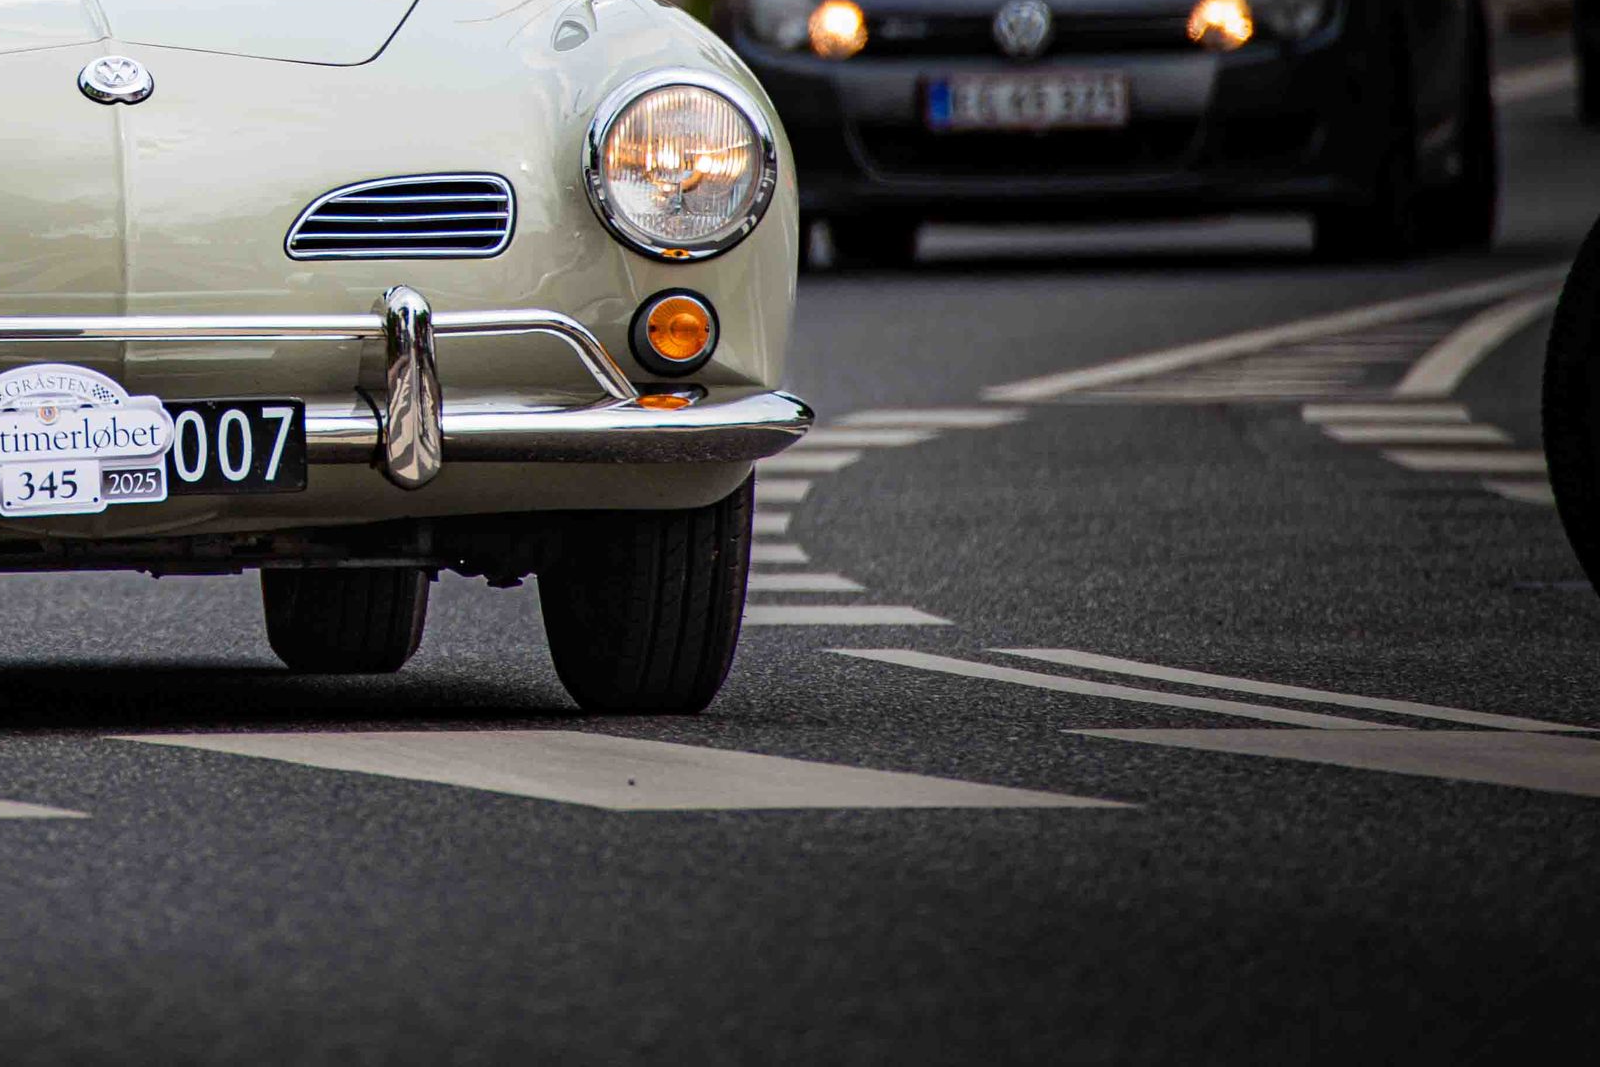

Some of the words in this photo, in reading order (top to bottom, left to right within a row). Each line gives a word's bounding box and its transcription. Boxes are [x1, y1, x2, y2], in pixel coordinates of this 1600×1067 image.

[4, 372, 90, 398] GRÅSTEN
[173, 407, 294, 482] 007
[17, 468, 78, 501] 345
[108, 471, 158, 496] 2025
